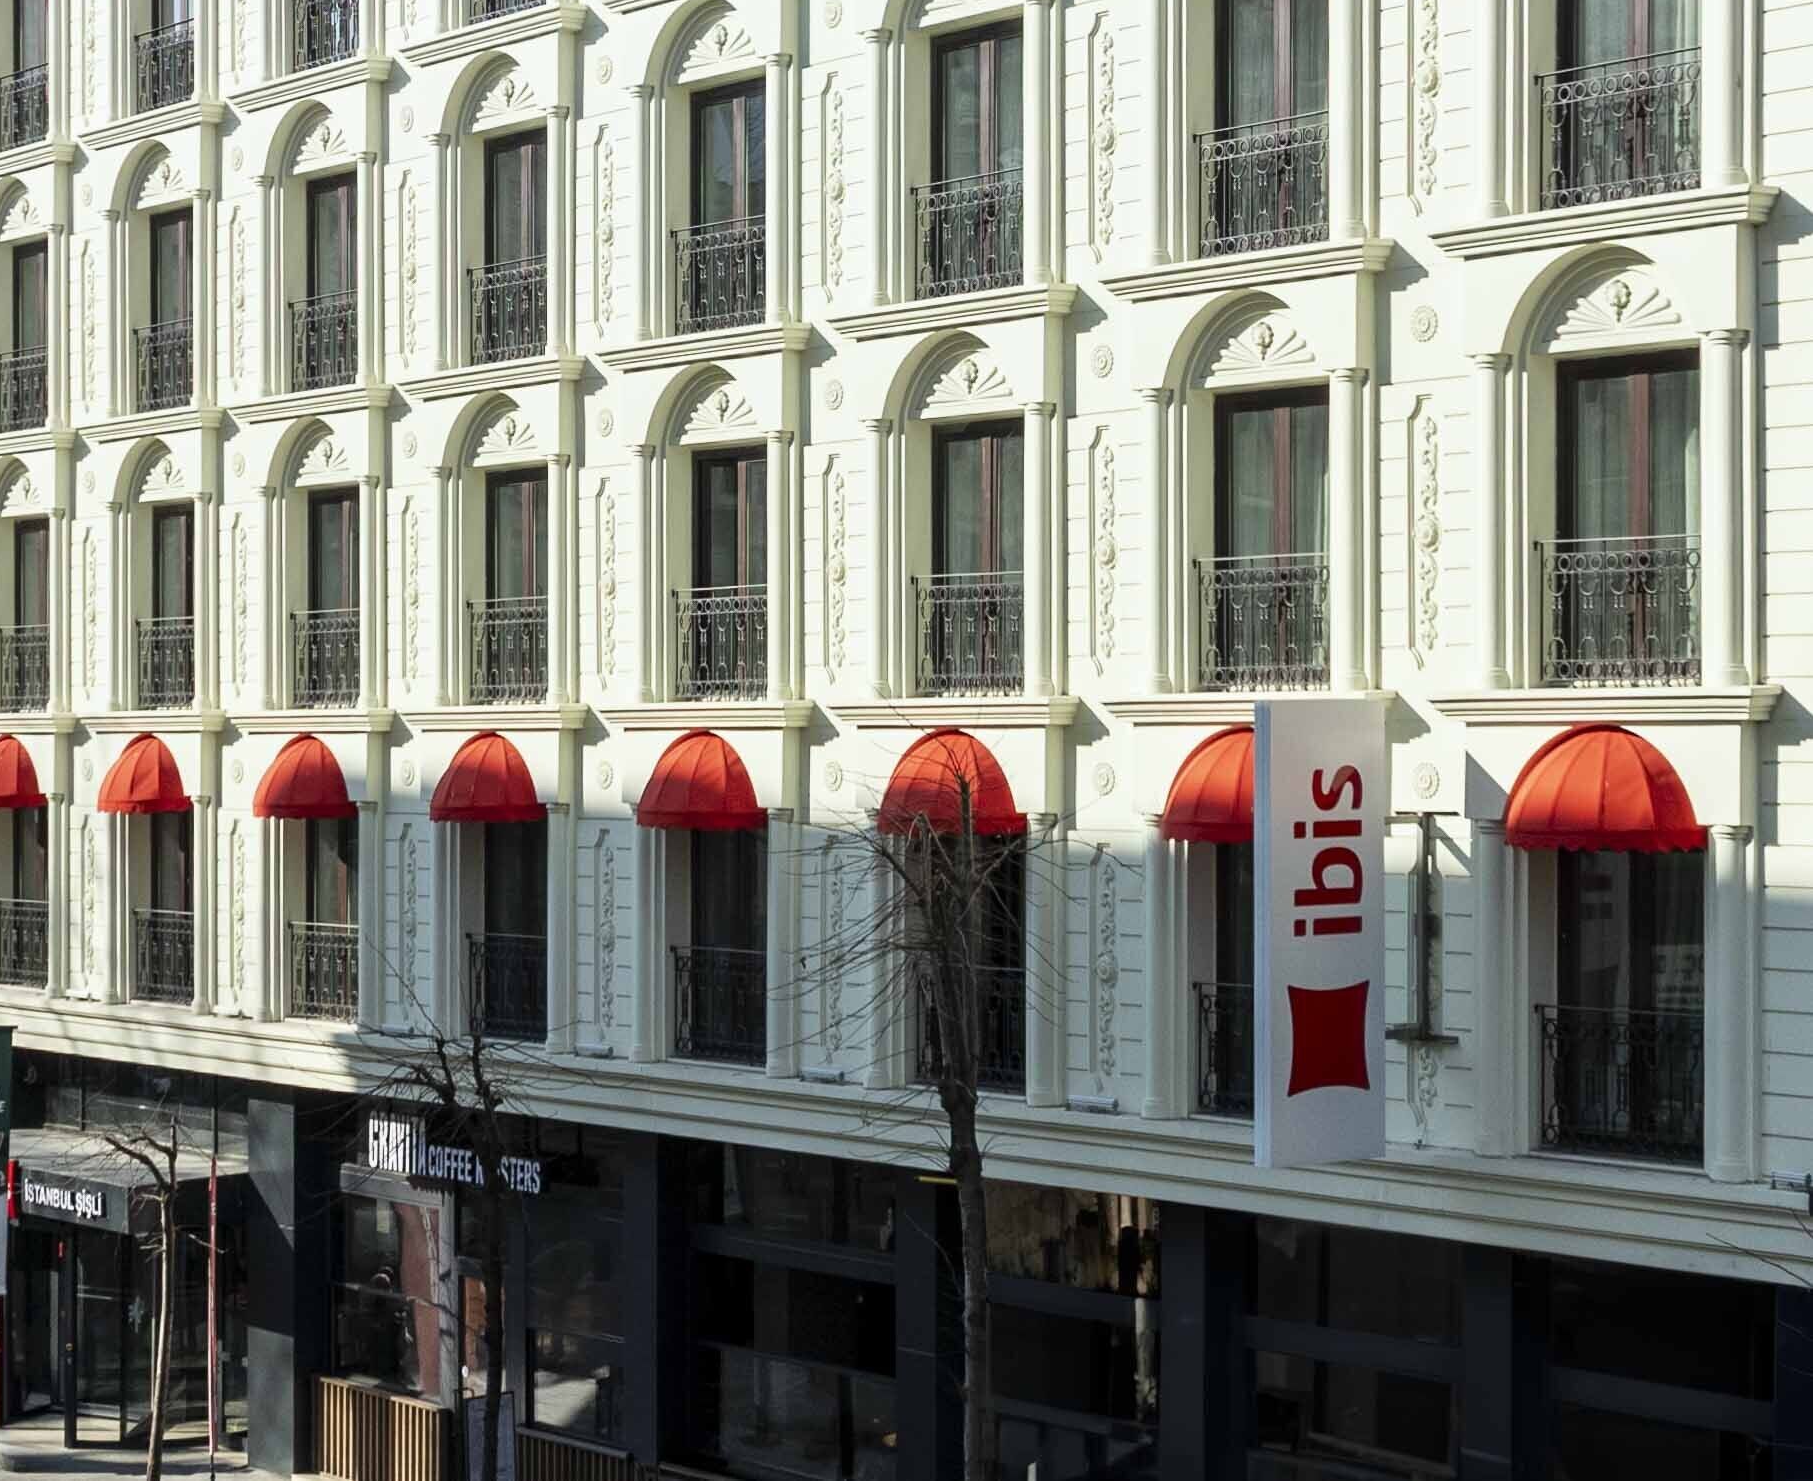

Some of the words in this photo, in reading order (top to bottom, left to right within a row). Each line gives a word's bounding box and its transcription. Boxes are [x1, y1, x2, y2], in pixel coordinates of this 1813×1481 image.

[1293, 765, 1363, 937] ibis
[427, 1144, 473, 1184] COFFEE
[24, 1178, 75, 1211] İSTANBUL
[75, 1189, 102, 1219] ŞİŞLİ
